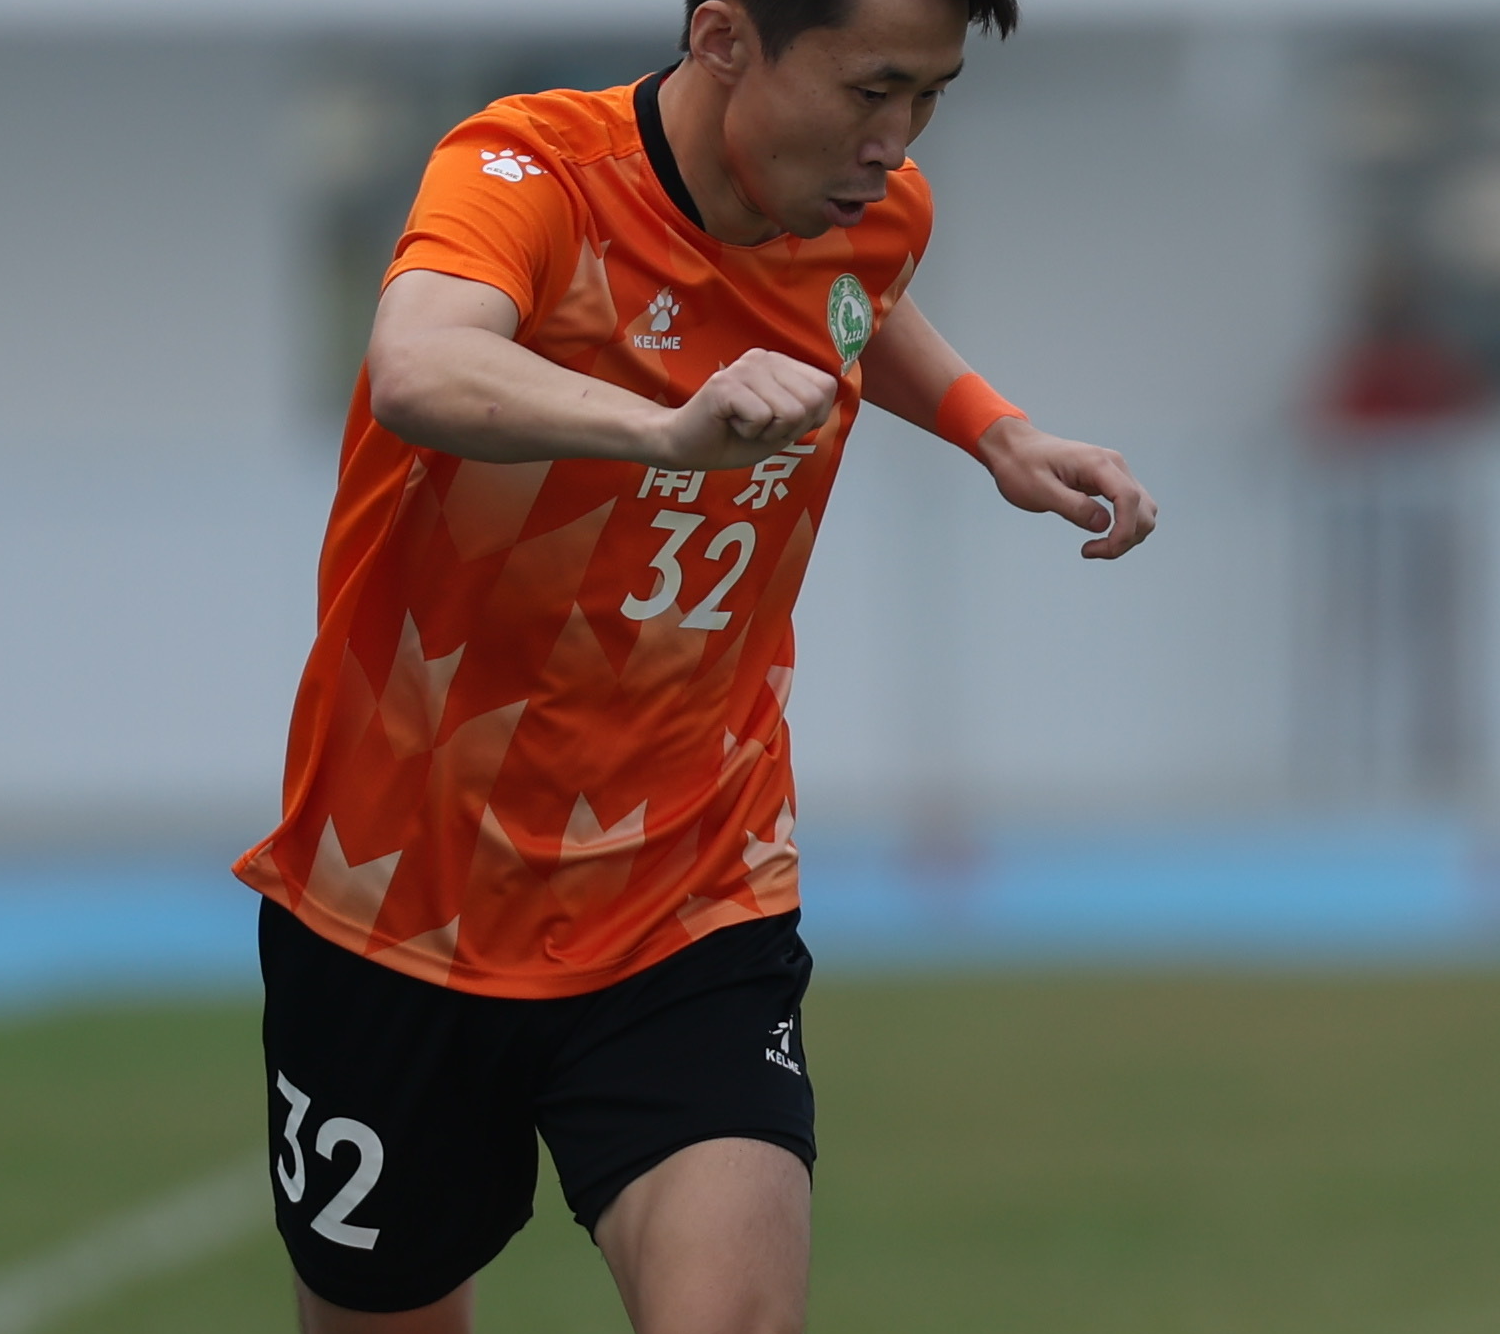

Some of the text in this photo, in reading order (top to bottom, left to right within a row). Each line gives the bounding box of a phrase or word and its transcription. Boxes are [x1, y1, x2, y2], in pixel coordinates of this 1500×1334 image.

[633, 334, 682, 350] KELME
[620, 509, 757, 631] 32
[765, 1047, 802, 1076] KELME
[276, 1068, 384, 1251] 32
